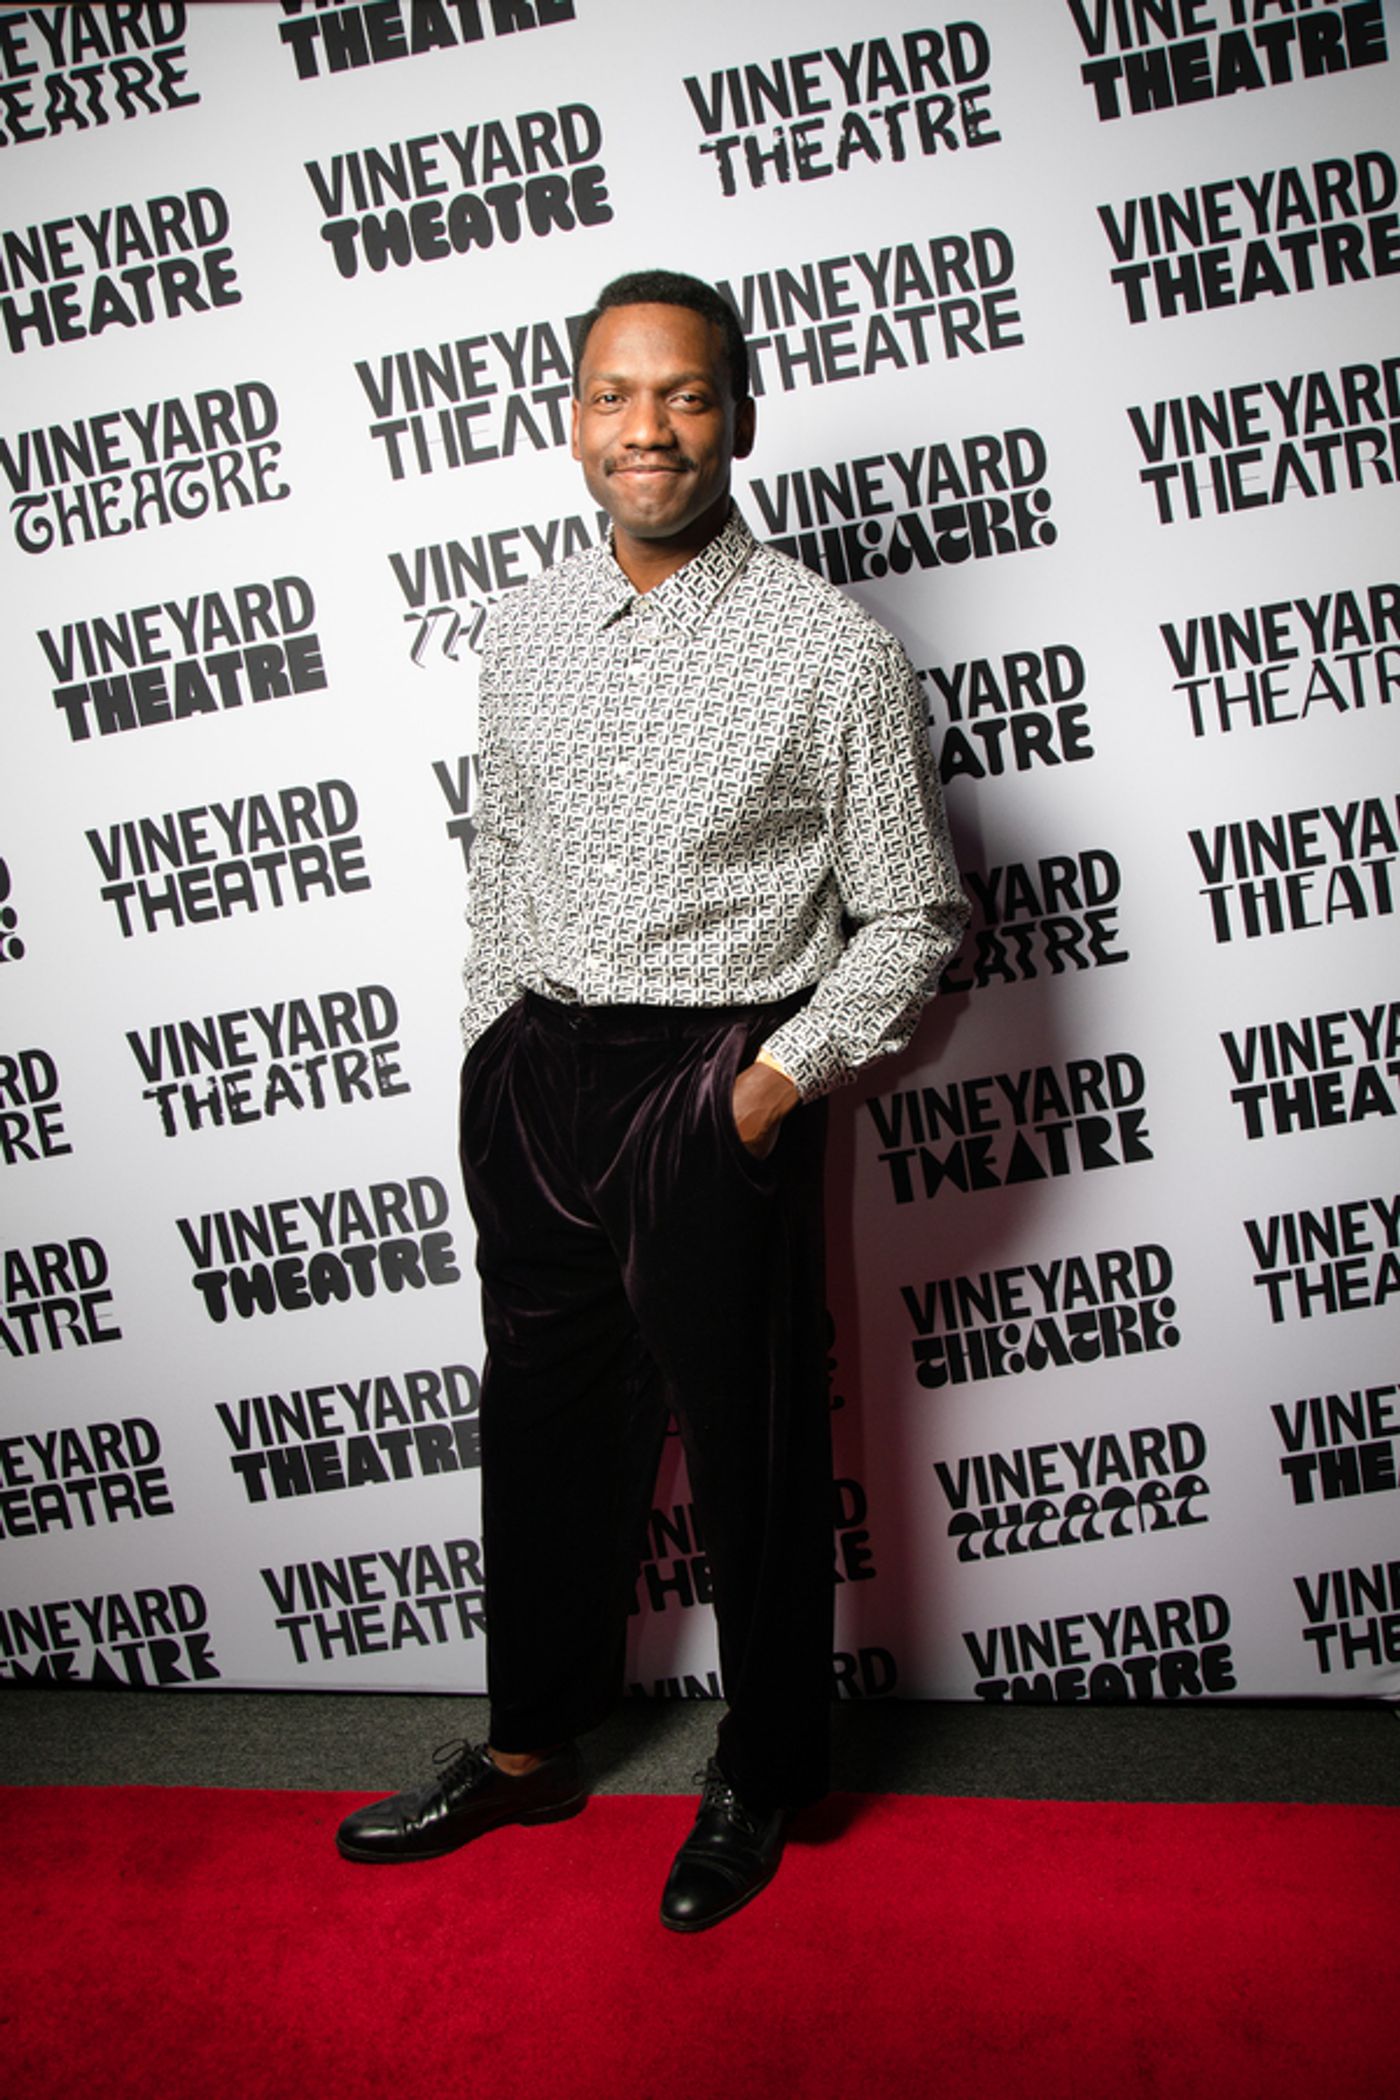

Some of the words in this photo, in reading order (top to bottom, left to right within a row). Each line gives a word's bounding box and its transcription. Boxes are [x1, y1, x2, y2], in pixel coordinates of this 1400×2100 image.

[0, 0, 188, 81] EYARD
[1067, 0, 1337, 57] VINE
[1080, 1, 1389, 122] THEATRE
[0, 45, 201, 148] EATRE
[682, 21, 990, 136] VINEYARD
[304, 102, 603, 219] VINEYARD
[699, 84, 1002, 197] THEATRE
[320, 165, 614, 279] THEATRE
[1097, 150, 1398, 263] VINEYARD
[0, 247, 243, 354] HEATRE
[715, 227, 1015, 335] VINEYARD
[1110, 213, 1400, 325] THEATRE
[744, 288, 1025, 397] THEATRE
[0, 381, 279, 494] VINEYARD
[749, 427, 1047, 535] VINEYARD
[10, 440, 291, 555] THEATRE
[387, 510, 612, 609] VINEYA
[37, 575, 317, 684] VINEYARD
[52, 632, 329, 742] THEATRE
[916, 644, 1086, 726] YARD
[85, 778, 360, 884] VINEYARD
[1187, 793, 1400, 885] VINEYA
[101, 836, 372, 938] THEATRE
[1199, 856, 1396, 945] THEAT
[126, 985, 399, 1084] VINEYARD
[143, 1041, 411, 1138] THEATRE
[866, 1052, 1146, 1149] VINEYARD
[1230, 1060, 1400, 1140] THEA
[878, 1109, 1154, 1203] THEATRE
[176, 1175, 449, 1269] VINEYARD
[192, 1231, 461, 1323] THEATRE
[901, 1243, 1173, 1335] VINEYARD
[912, 1296, 1181, 1389] THEATRE
[0, 1417, 161, 1488] EYARD
[215, 1364, 482, 1451] VINEYARD
[1270, 1383, 1400, 1452] VINE
[0, 1467, 175, 1539] EATRE
[230, 1416, 482, 1503] THEATRE
[933, 1421, 1207, 1510] VINEYARD
[1280, 1440, 1400, 1506] THE
[947, 1474, 1210, 1562] THEATRE
[962, 1593, 1231, 1678] VINEYARD
